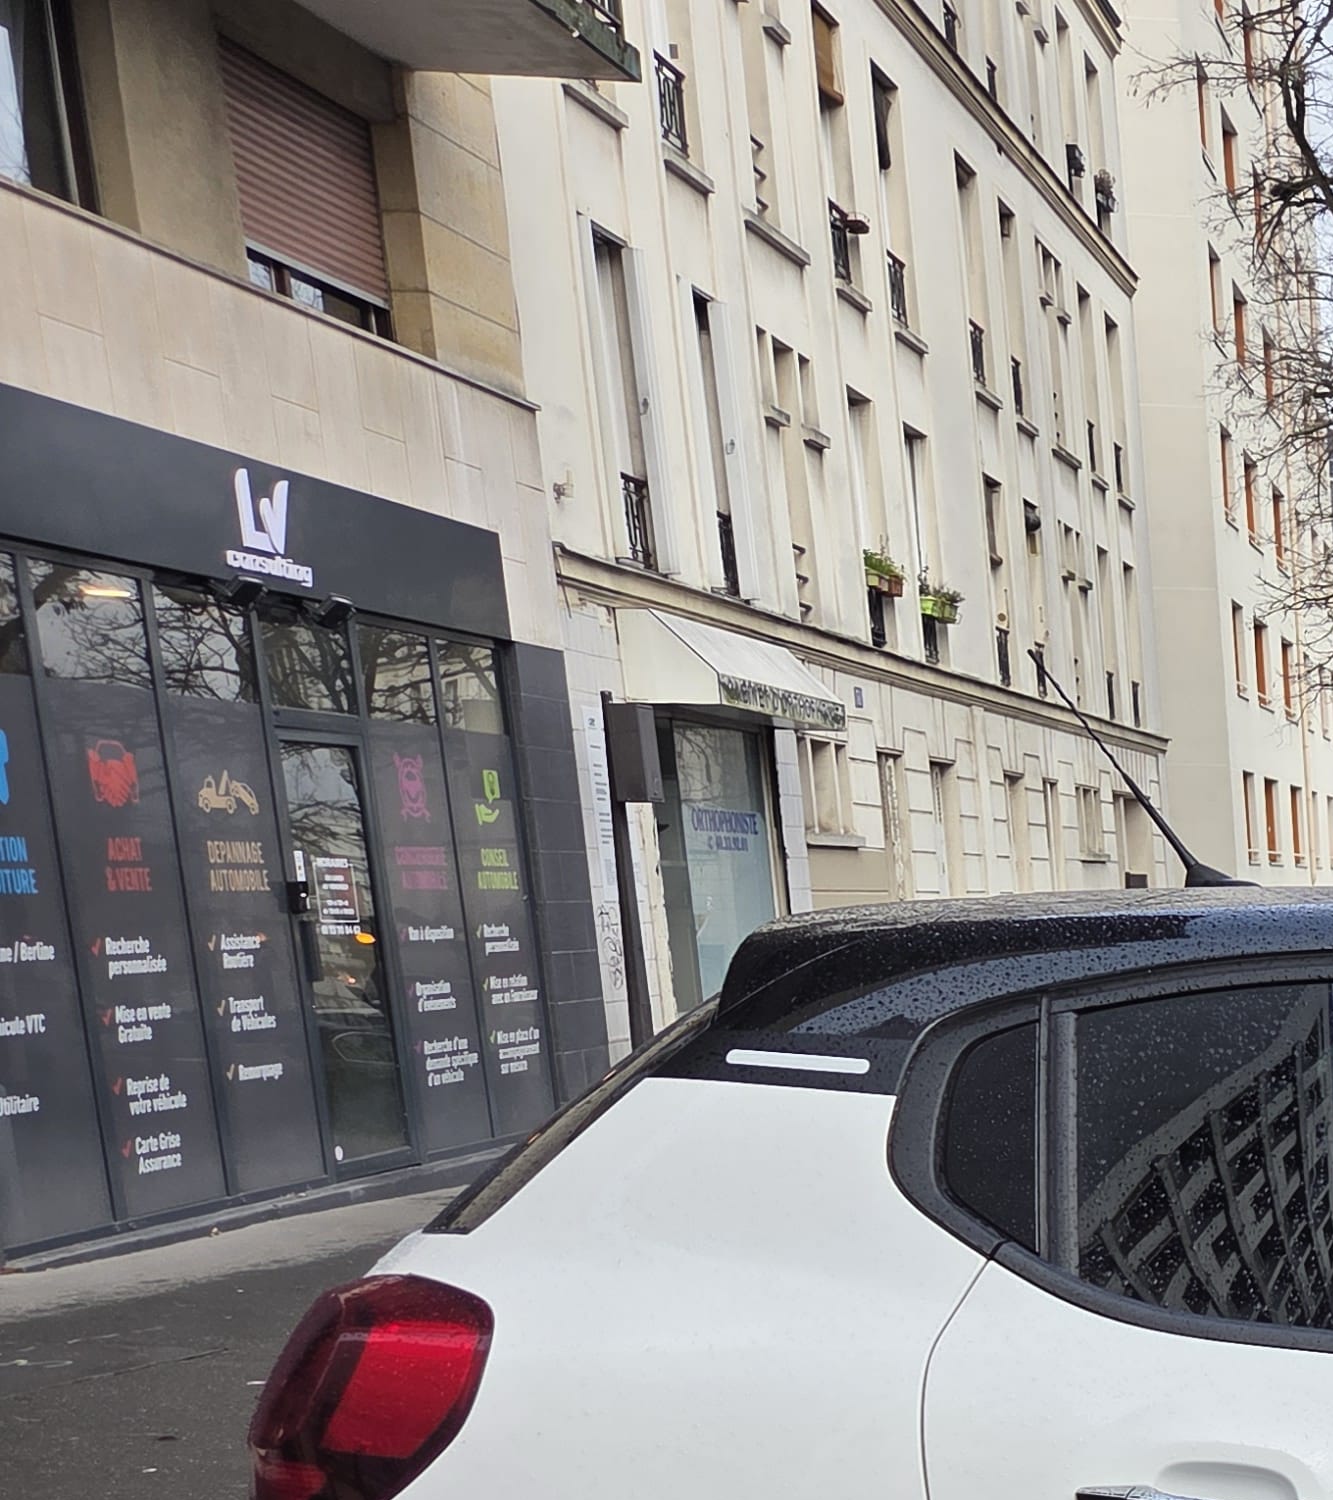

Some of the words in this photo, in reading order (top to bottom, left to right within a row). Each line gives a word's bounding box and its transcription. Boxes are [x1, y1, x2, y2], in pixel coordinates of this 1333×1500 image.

[107, 837, 143, 862] ACHAT
[206, 840, 265, 865] DEPANNAGE
[116, 867, 152, 892] VENTE
[209, 868, 271, 892] AUTOMOBILE
[20, 941, 55, 961] Berline
[105, 936, 150, 955] Recherche
[220, 933, 261, 950] Assistance
[109, 954, 168, 980] personnalisée
[115, 1005, 135, 1024] Mise
[136, 1007, 148, 1022] en
[148, 1002, 172, 1020] vente
[227, 995, 265, 1014] Transport
[26, 1013, 46, 1034] VTC
[231, 1015, 241, 1032] de
[126, 1076, 158, 1098] Reprise
[159, 1073, 170, 1091] de
[129, 1098, 152, 1116] votre
[152, 1090, 187, 1112] véhicule
[135, 1136, 158, 1155] Carte
[159, 1131, 181, 1150] Grise
[138, 1153, 182, 1175] Assurance
